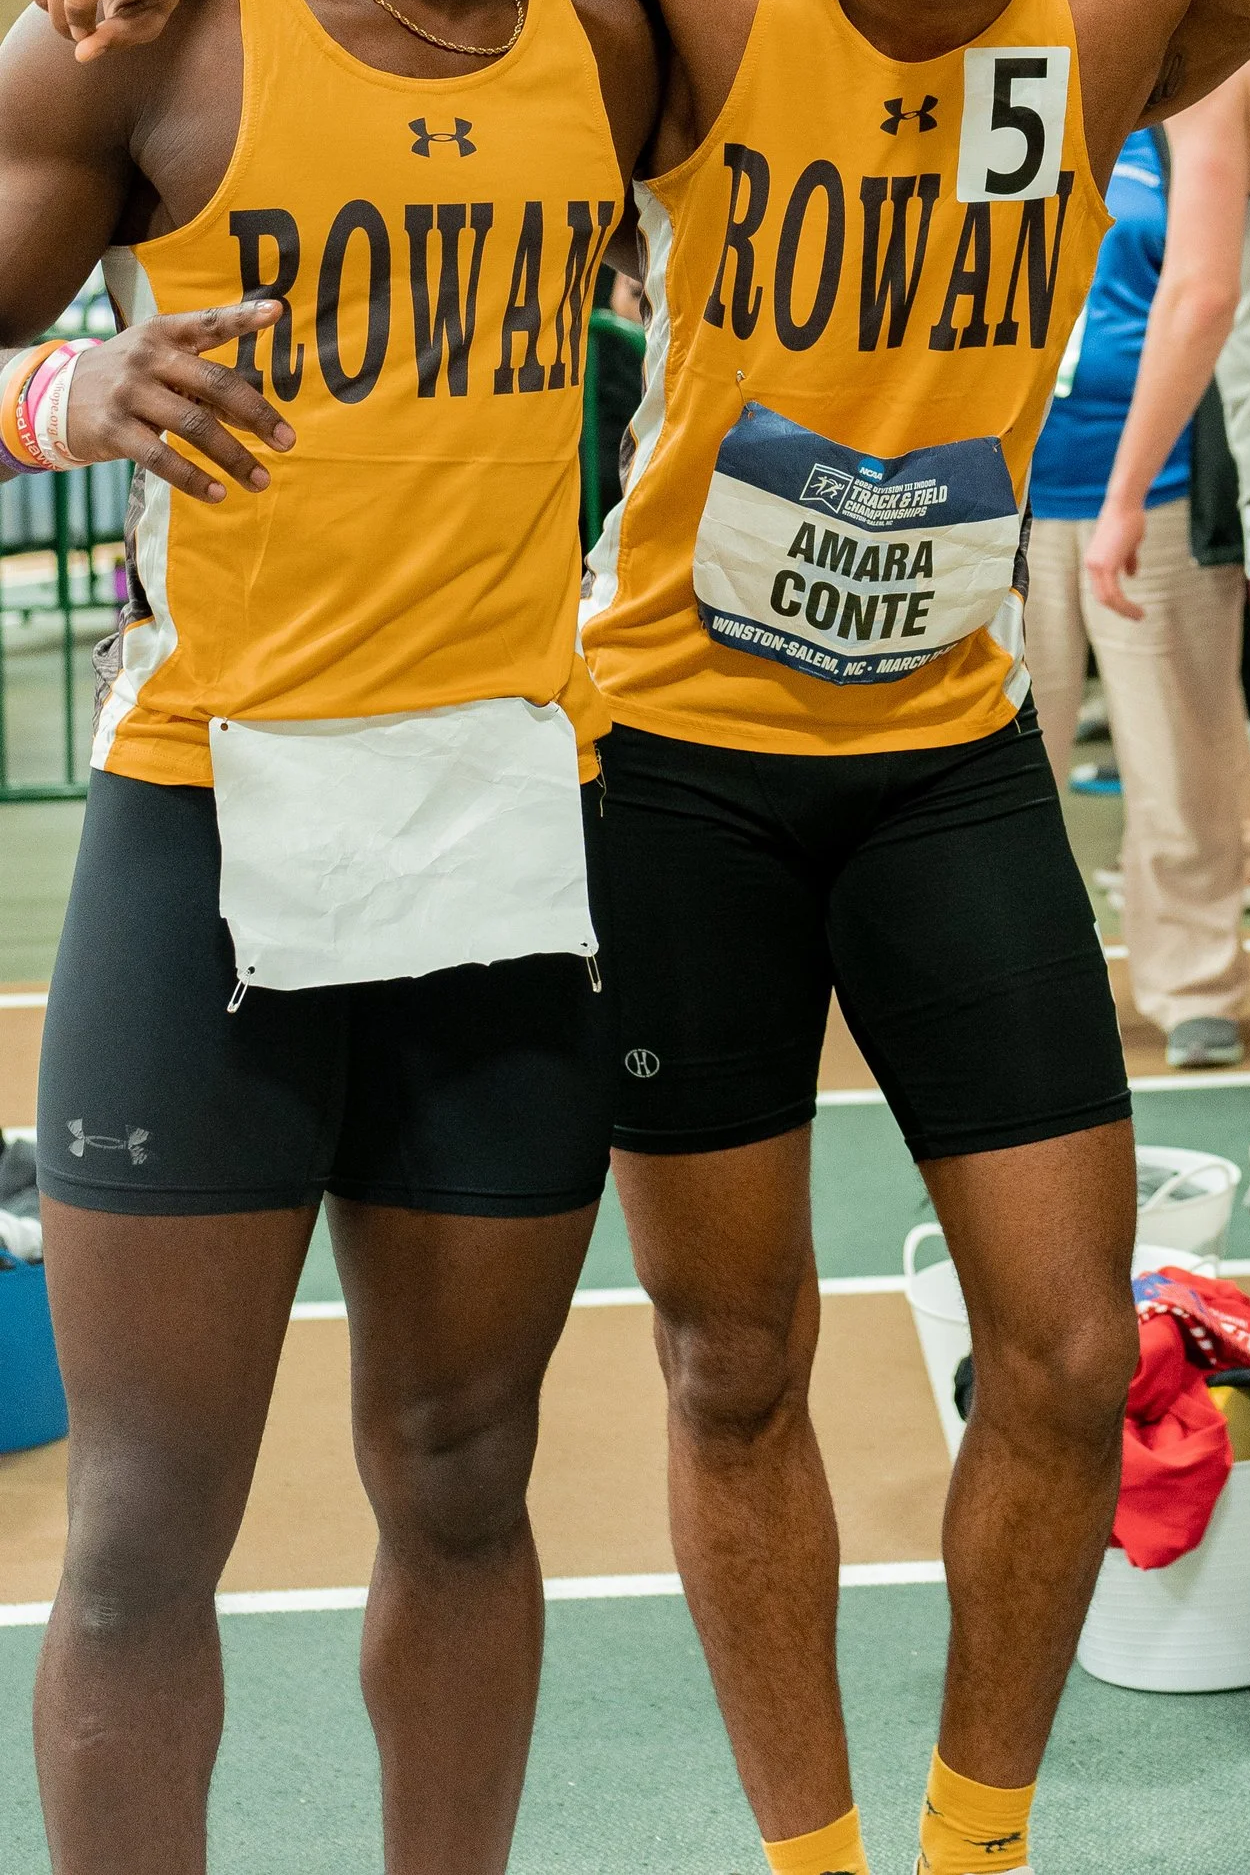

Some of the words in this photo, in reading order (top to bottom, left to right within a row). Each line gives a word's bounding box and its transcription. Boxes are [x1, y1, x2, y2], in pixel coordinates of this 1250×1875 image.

[984, 57, 1048, 195] 5
[703, 143, 1075, 352] ROWAN
[229, 199, 616, 404] ROWAN
[850, 486, 900, 509] TRACK
[899, 495, 911, 509] &
[911, 485, 948, 507] FIELD
[854, 479, 873, 489] 2022
[873, 484, 904, 494] DIVISION
[913, 479, 936, 490] INDOOR
[859, 466, 883, 481] NCAA
[844, 499, 927, 520] CHAMPIONSHIPS
[787, 521, 934, 583] AMARA
[770, 569, 935, 641] CONTE
[712, 615, 839, 675] WINSTON-SALEM,
[843, 661, 867, 676] NC
[876, 653, 931, 673] MARCH
